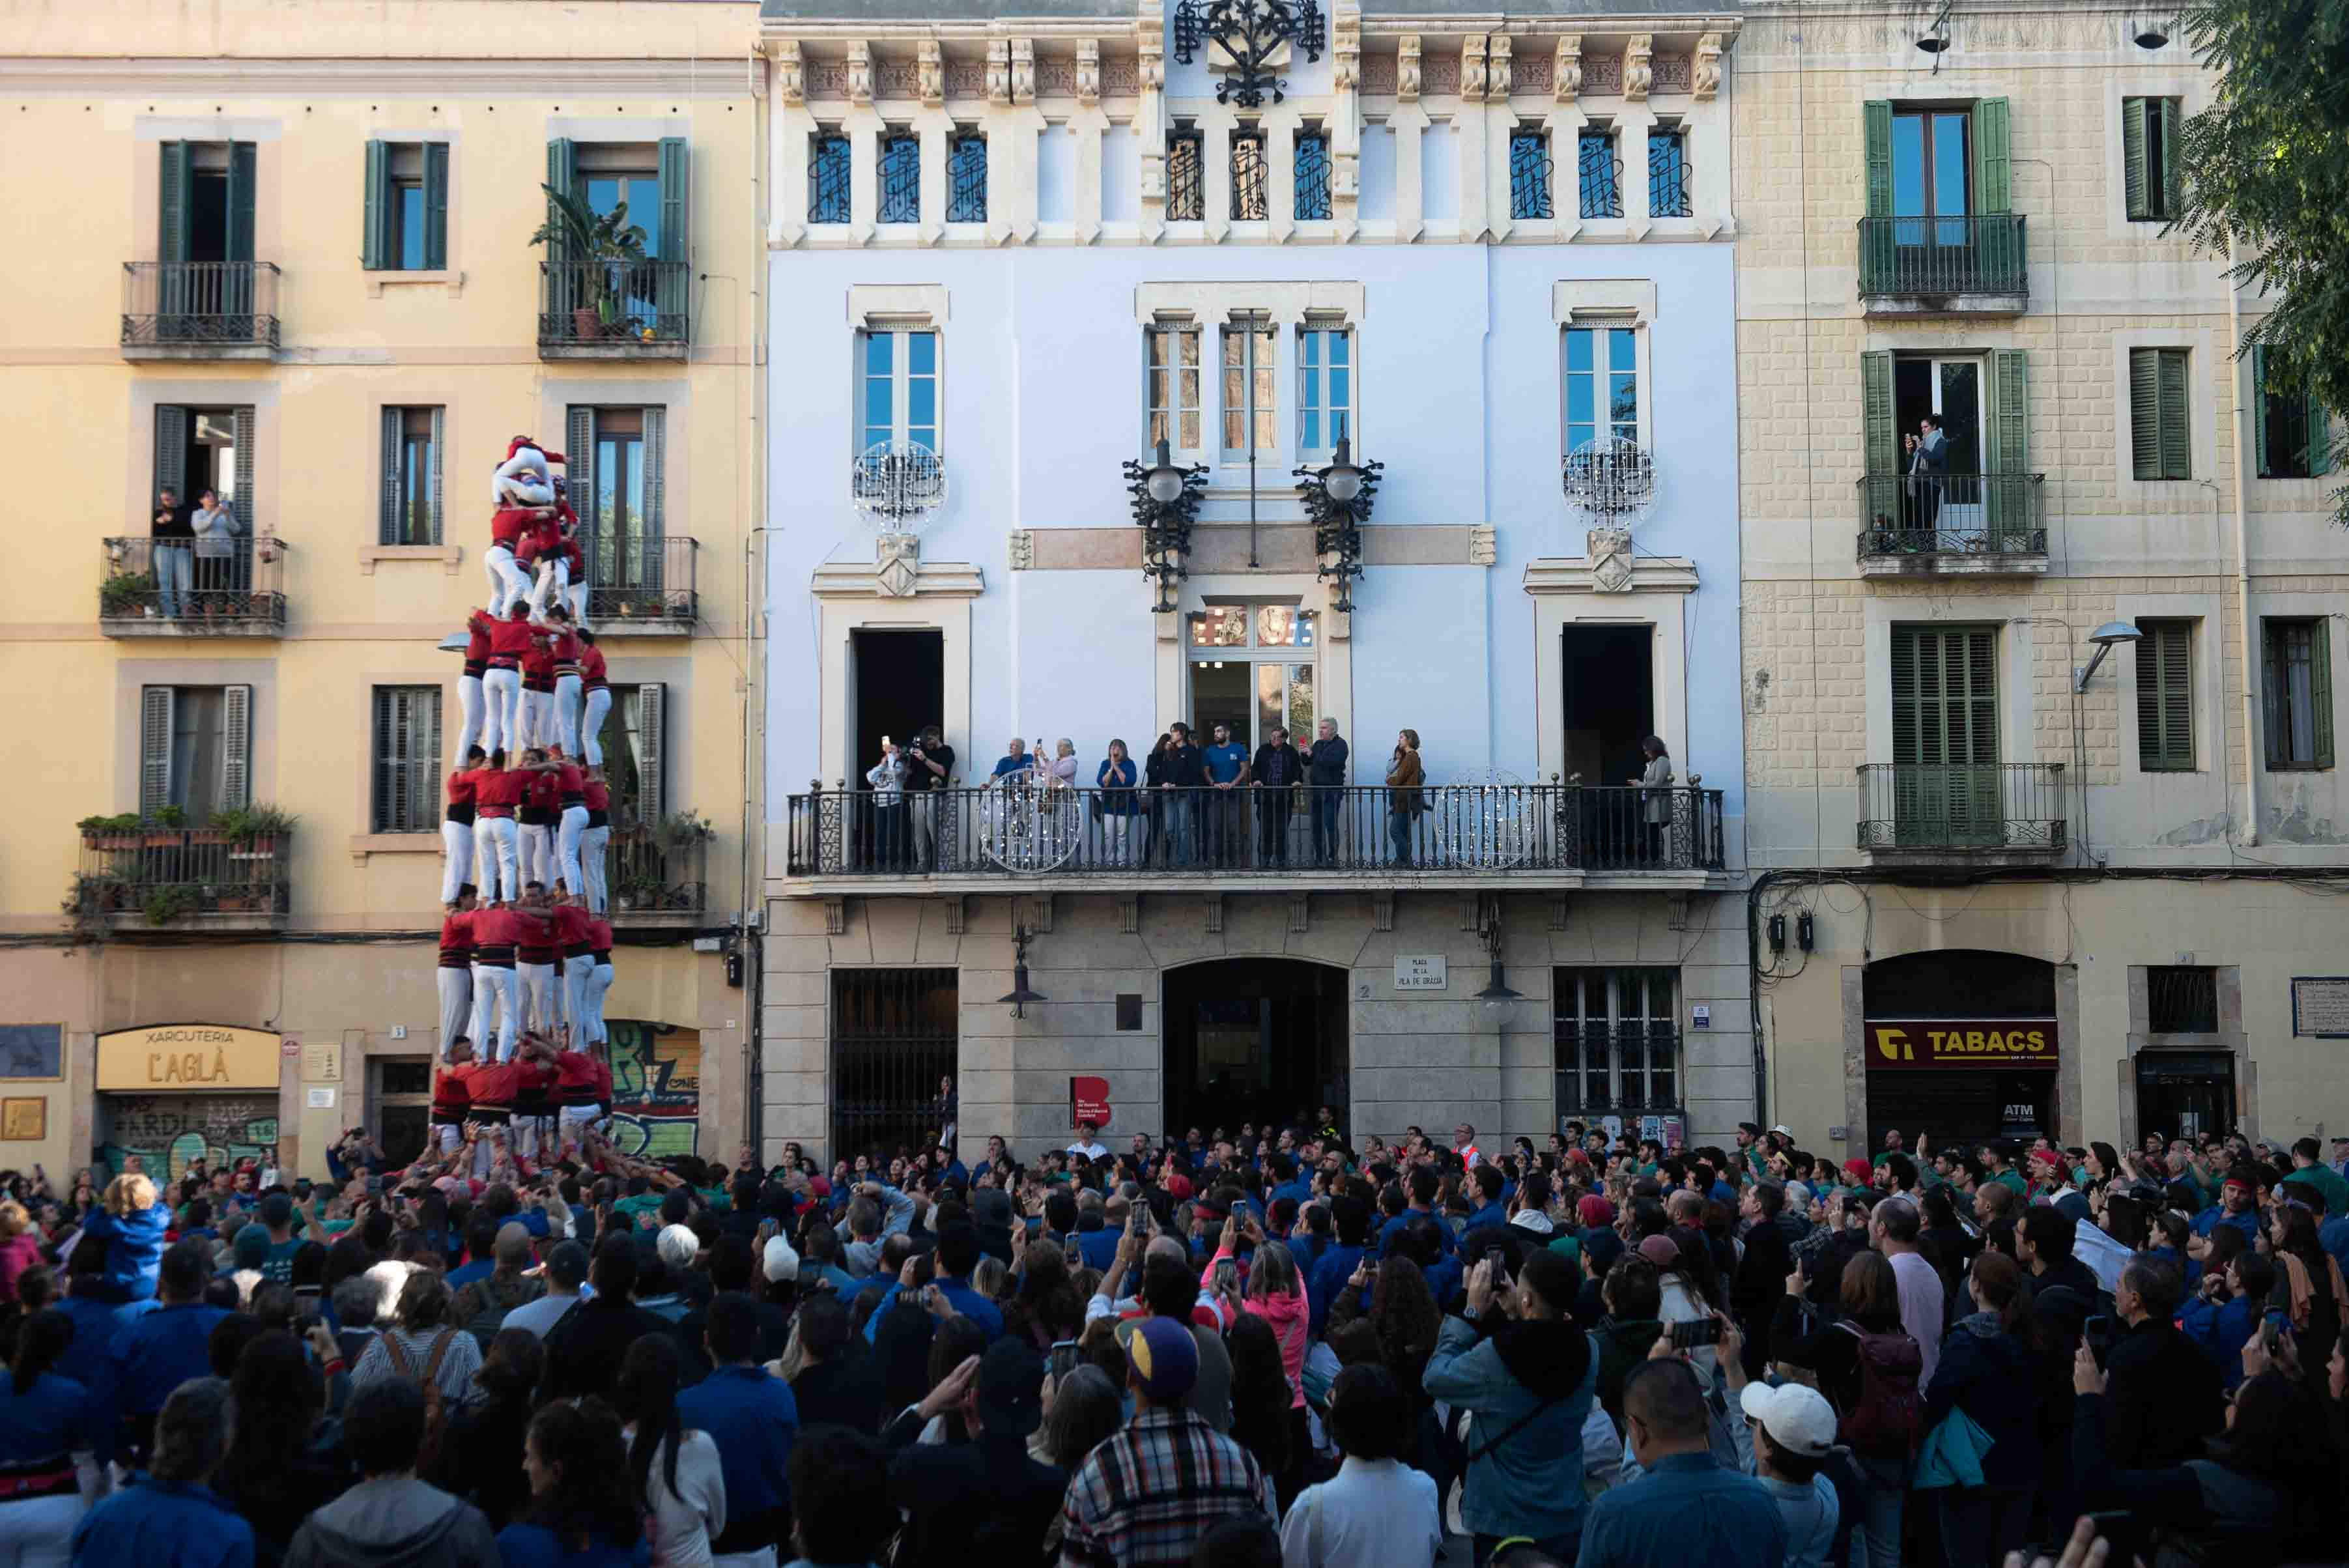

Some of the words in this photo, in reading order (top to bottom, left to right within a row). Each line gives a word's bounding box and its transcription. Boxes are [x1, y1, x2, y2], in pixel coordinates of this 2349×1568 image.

[1360, 984, 1370, 999] 2
[146, 1031, 234, 1044] XARCUTERIA
[1927, 1031, 2045, 1052] TABACS
[2004, 1104, 2033, 1115] ATM
